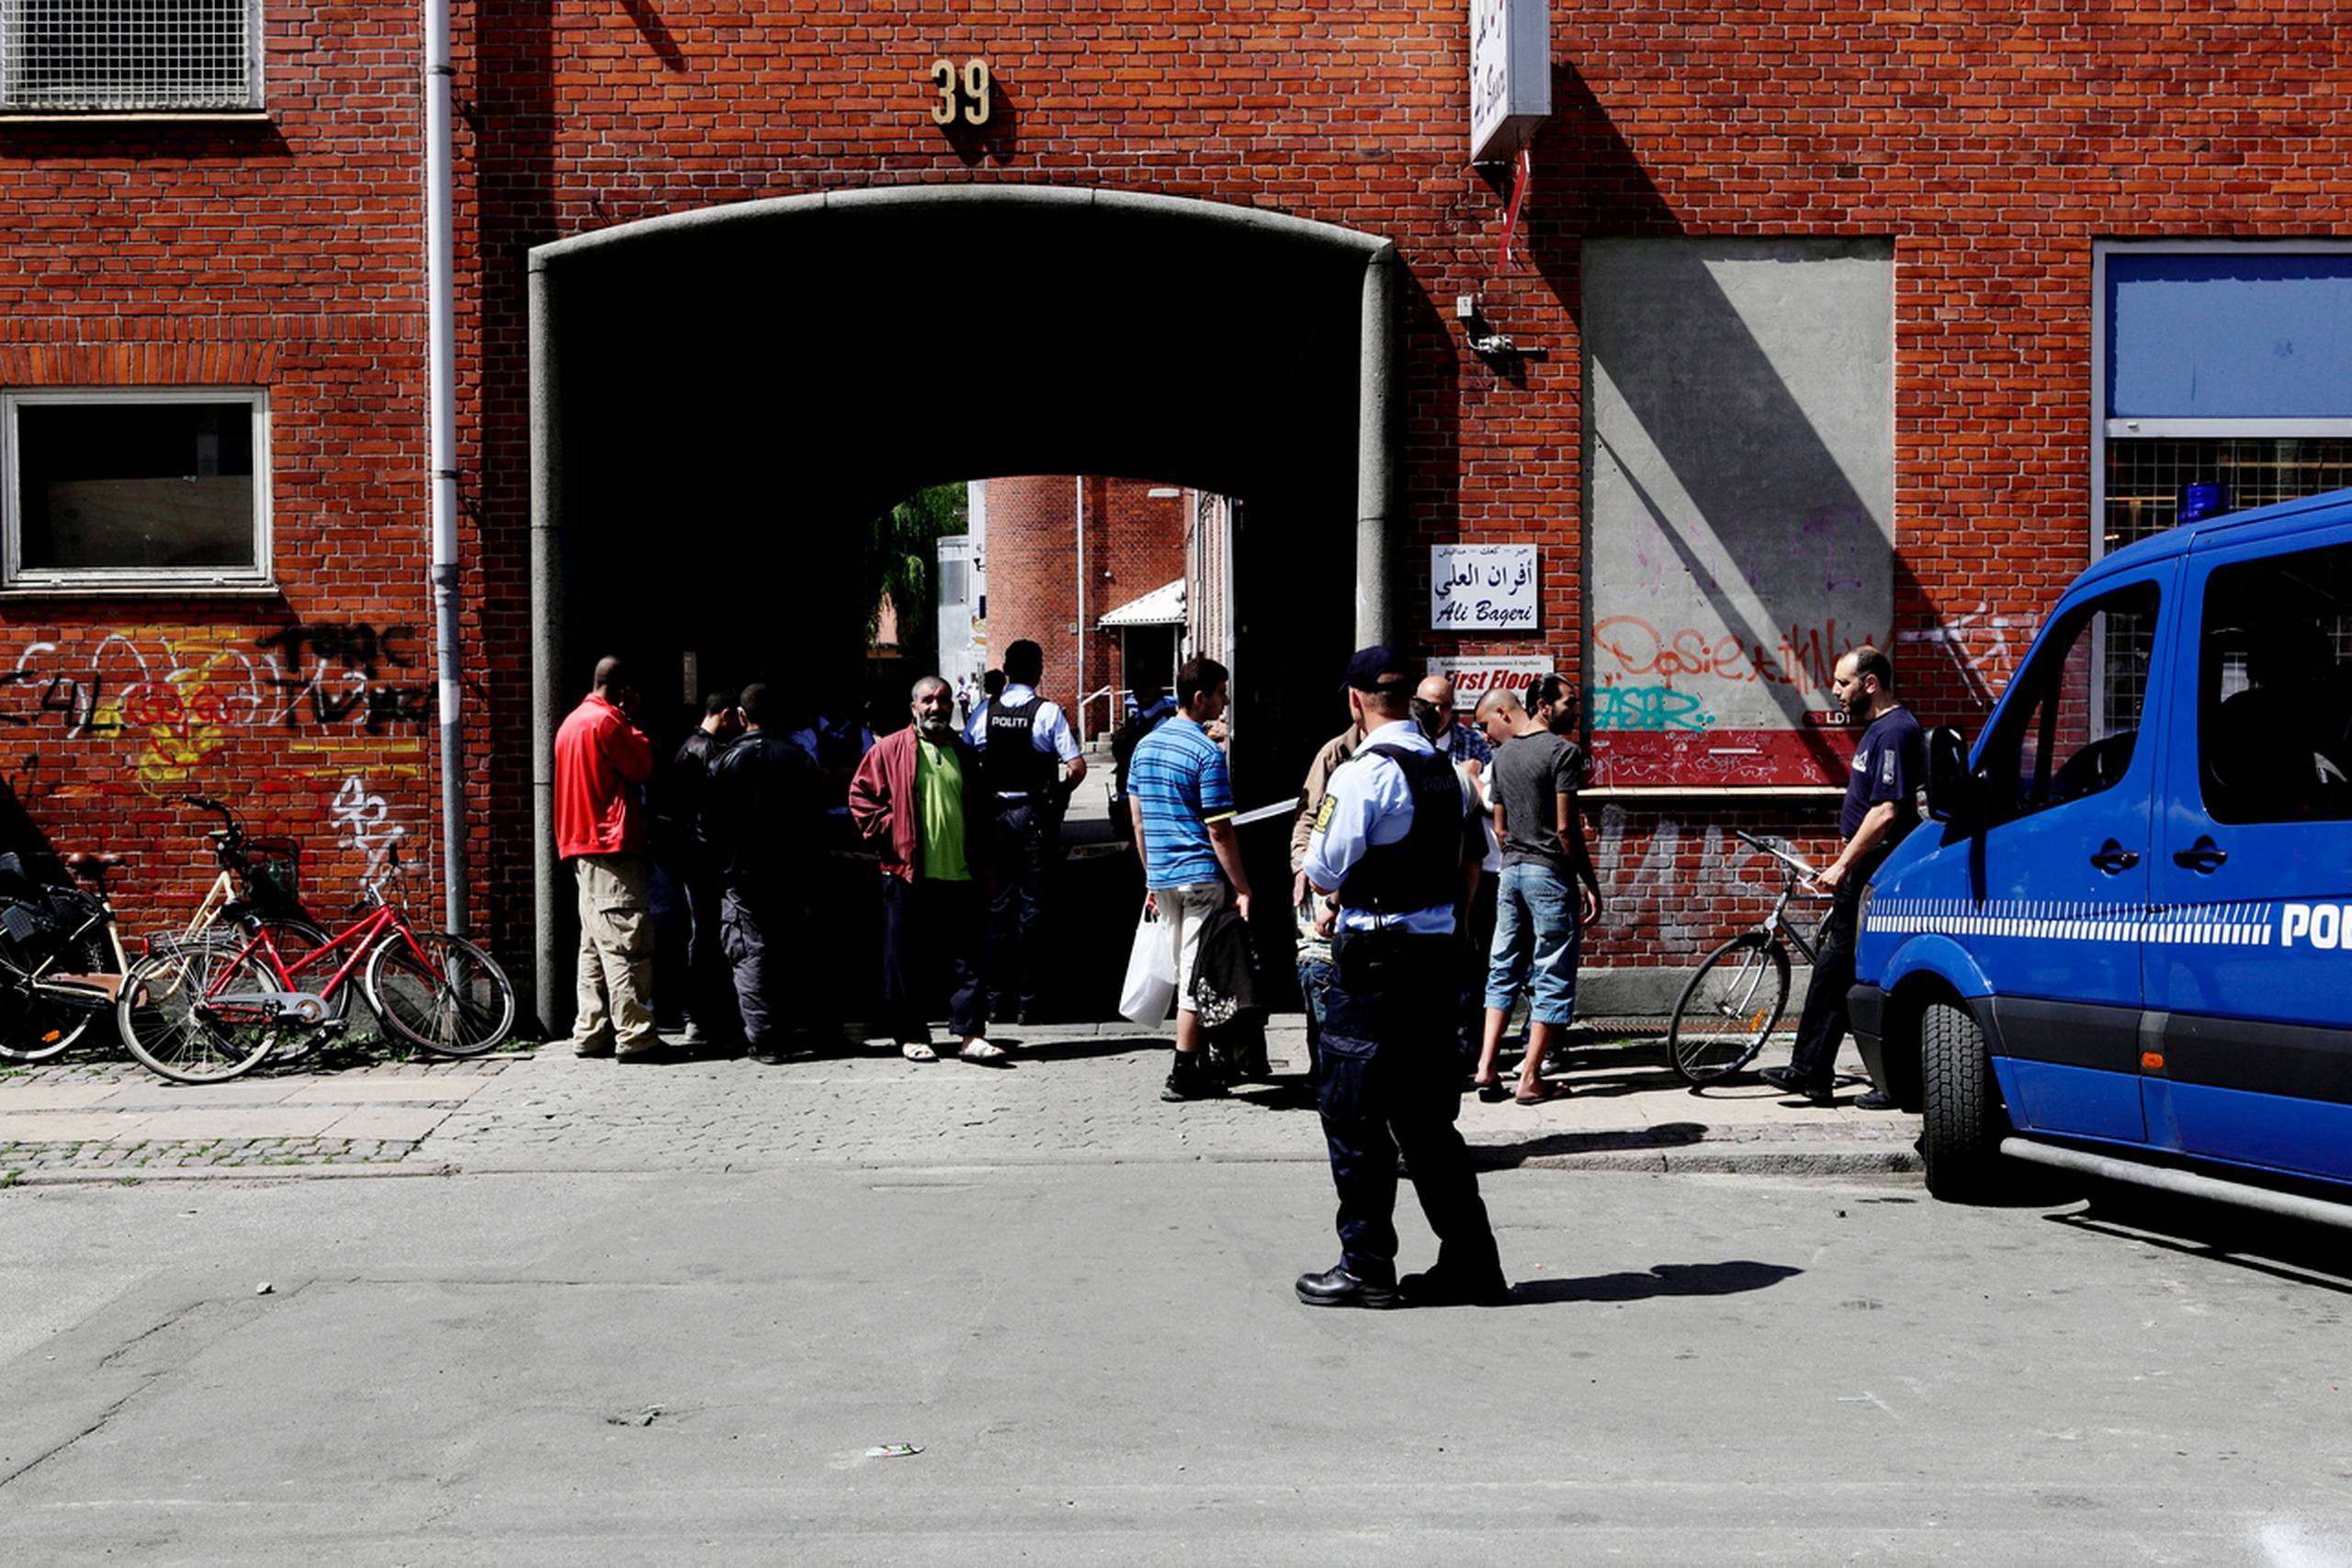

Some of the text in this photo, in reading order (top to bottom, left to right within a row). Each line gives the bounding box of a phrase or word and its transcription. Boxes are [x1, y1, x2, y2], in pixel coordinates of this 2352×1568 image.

[932, 59, 989, 125] 39
[1435, 558, 1532, 599] أفران العلي
[1436, 600, 1532, 627] Ali Bageri
[1445, 670, 1488, 691] First
[991, 716, 1028, 728] POLITI
